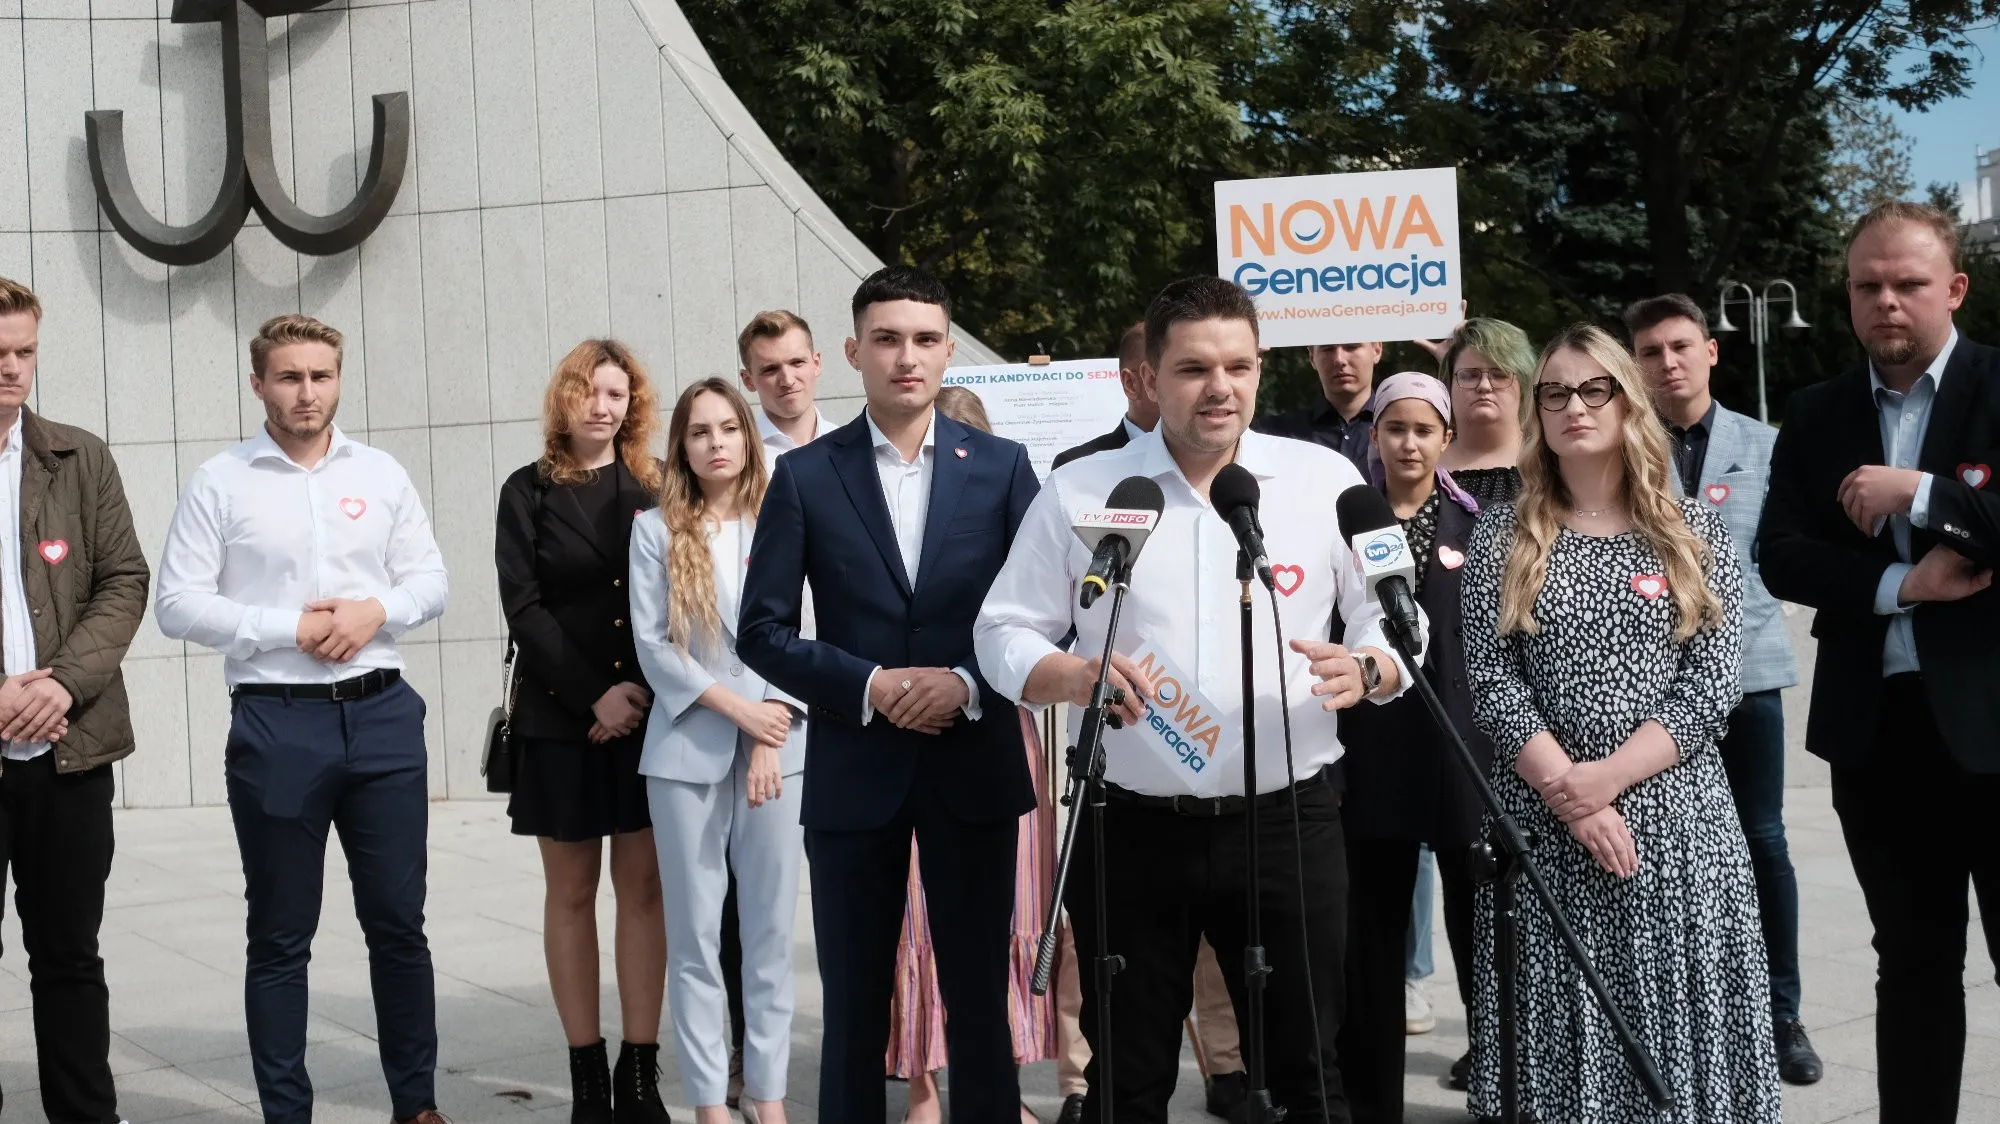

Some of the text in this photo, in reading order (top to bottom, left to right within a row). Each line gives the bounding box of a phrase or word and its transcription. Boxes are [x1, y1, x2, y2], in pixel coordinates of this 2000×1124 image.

[1229, 194, 1444, 258] NOWA
[1233, 254, 1447, 298] Generacja
[1257, 300, 1448, 321] ww.NowaGeneracja.org
[990, 372, 1062, 384] KANDYDACI
[1066, 371, 1084, 380] DO
[1087, 370, 1119, 379] SEJM
[1114, 514, 1147, 523] INFO
[1138, 652, 1222, 758] NOWA
[1144, 703, 1206, 774] neracja
